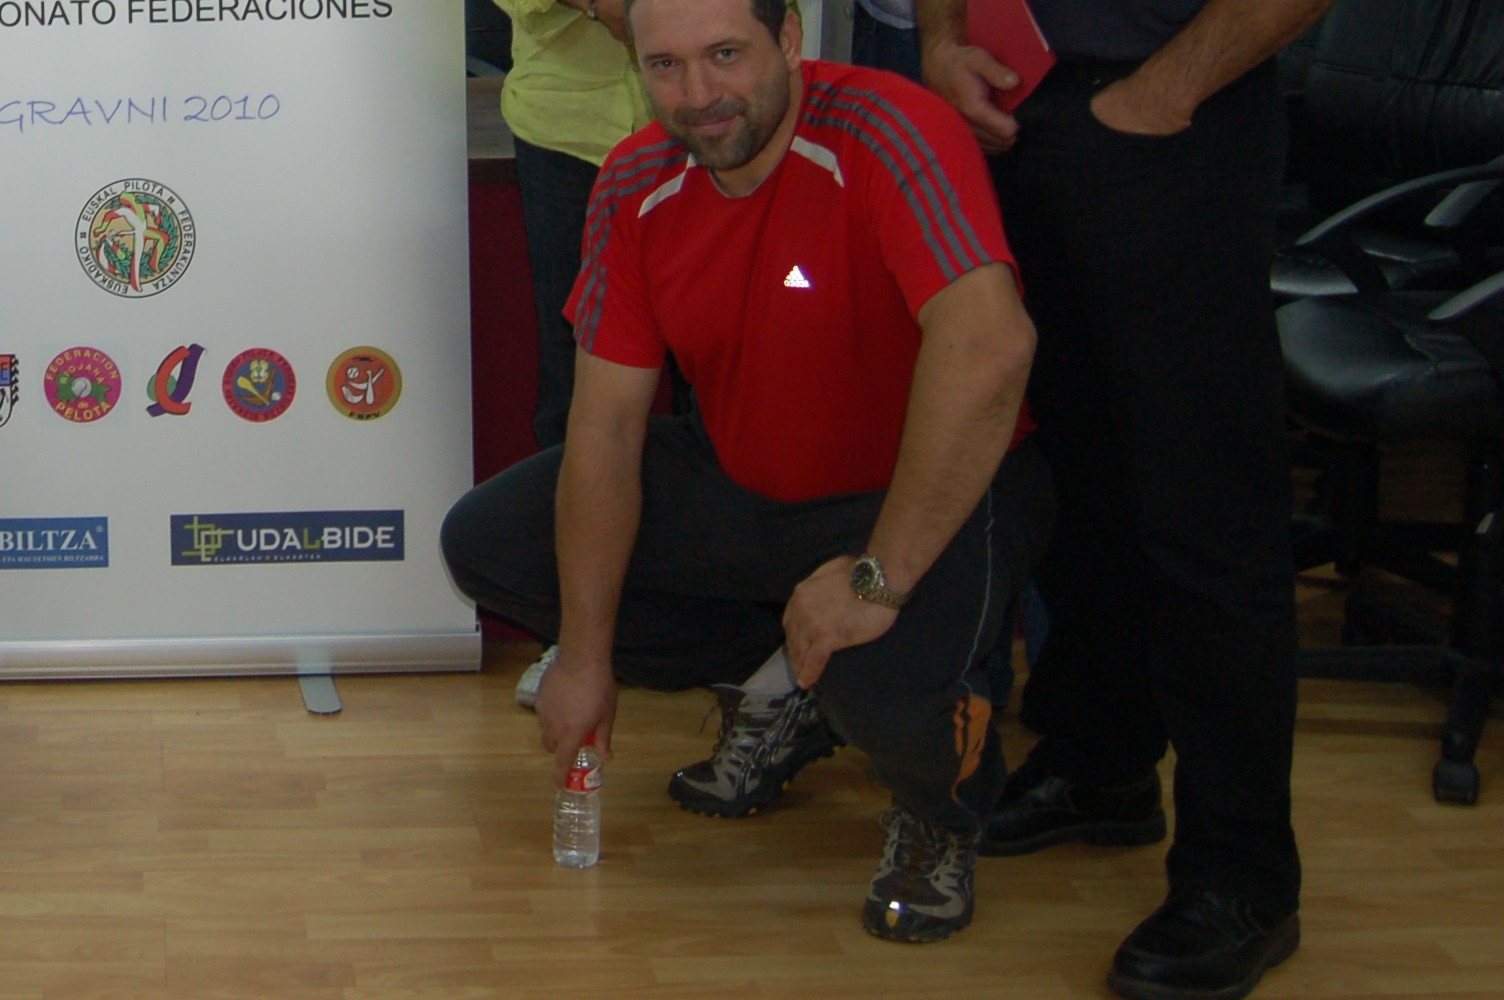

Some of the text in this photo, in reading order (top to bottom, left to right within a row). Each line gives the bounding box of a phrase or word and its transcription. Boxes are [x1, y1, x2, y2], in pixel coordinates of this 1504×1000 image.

[184, 94, 281, 122] 2010
[79, 181, 194, 294] EUSKADIKO EUSKAL PILOTA FEDERAKUNTZA
[46, 349, 118, 380] FEDERACION
[60, 362, 105, 384] RIOJANA
[56, 402, 110, 421] PELOTA
[236, 526, 395, 551] UDALBIDE
